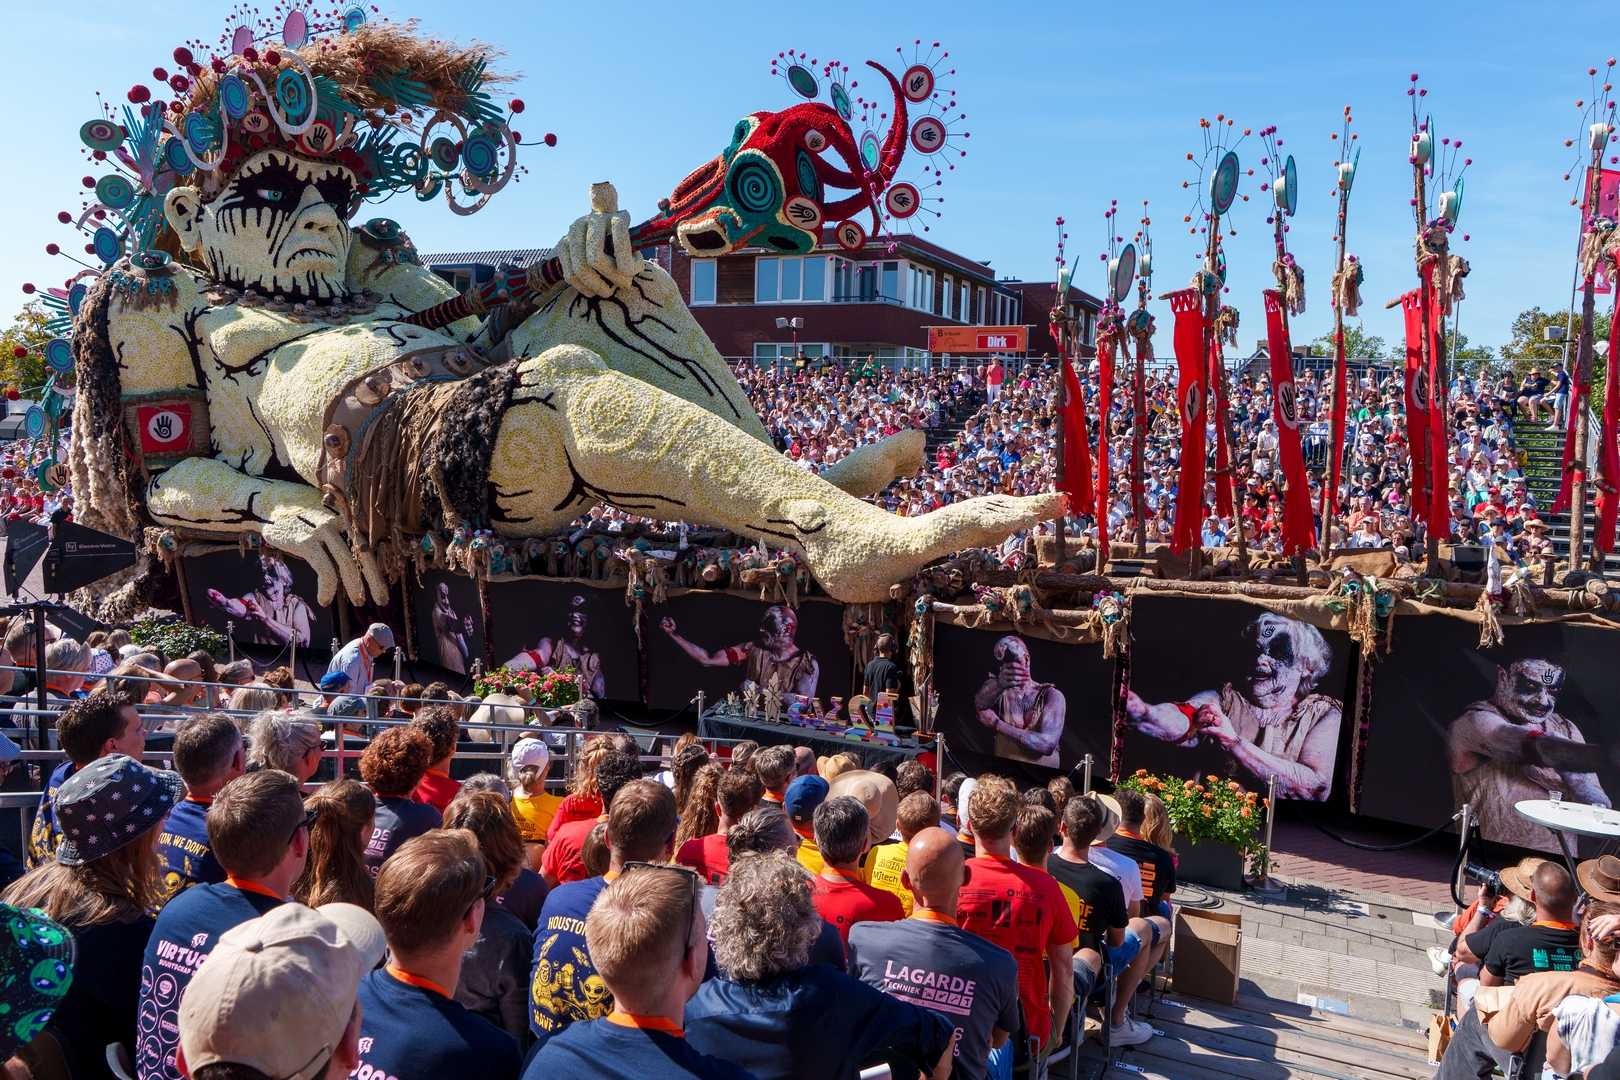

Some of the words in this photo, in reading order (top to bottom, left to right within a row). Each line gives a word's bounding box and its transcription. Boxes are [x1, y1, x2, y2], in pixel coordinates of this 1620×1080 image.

[938, 329, 943, 337] B
[987, 336, 1007, 348] Dirk
[173, 835, 186, 848] WE
[184, 839, 210, 858] DON'T
[1016, 890, 1044, 900] MAUSER
[157, 940, 208, 969] VIRTUO
[885, 960, 976, 996] LAGARDE
[884, 979, 921, 995] TECHNIEK
